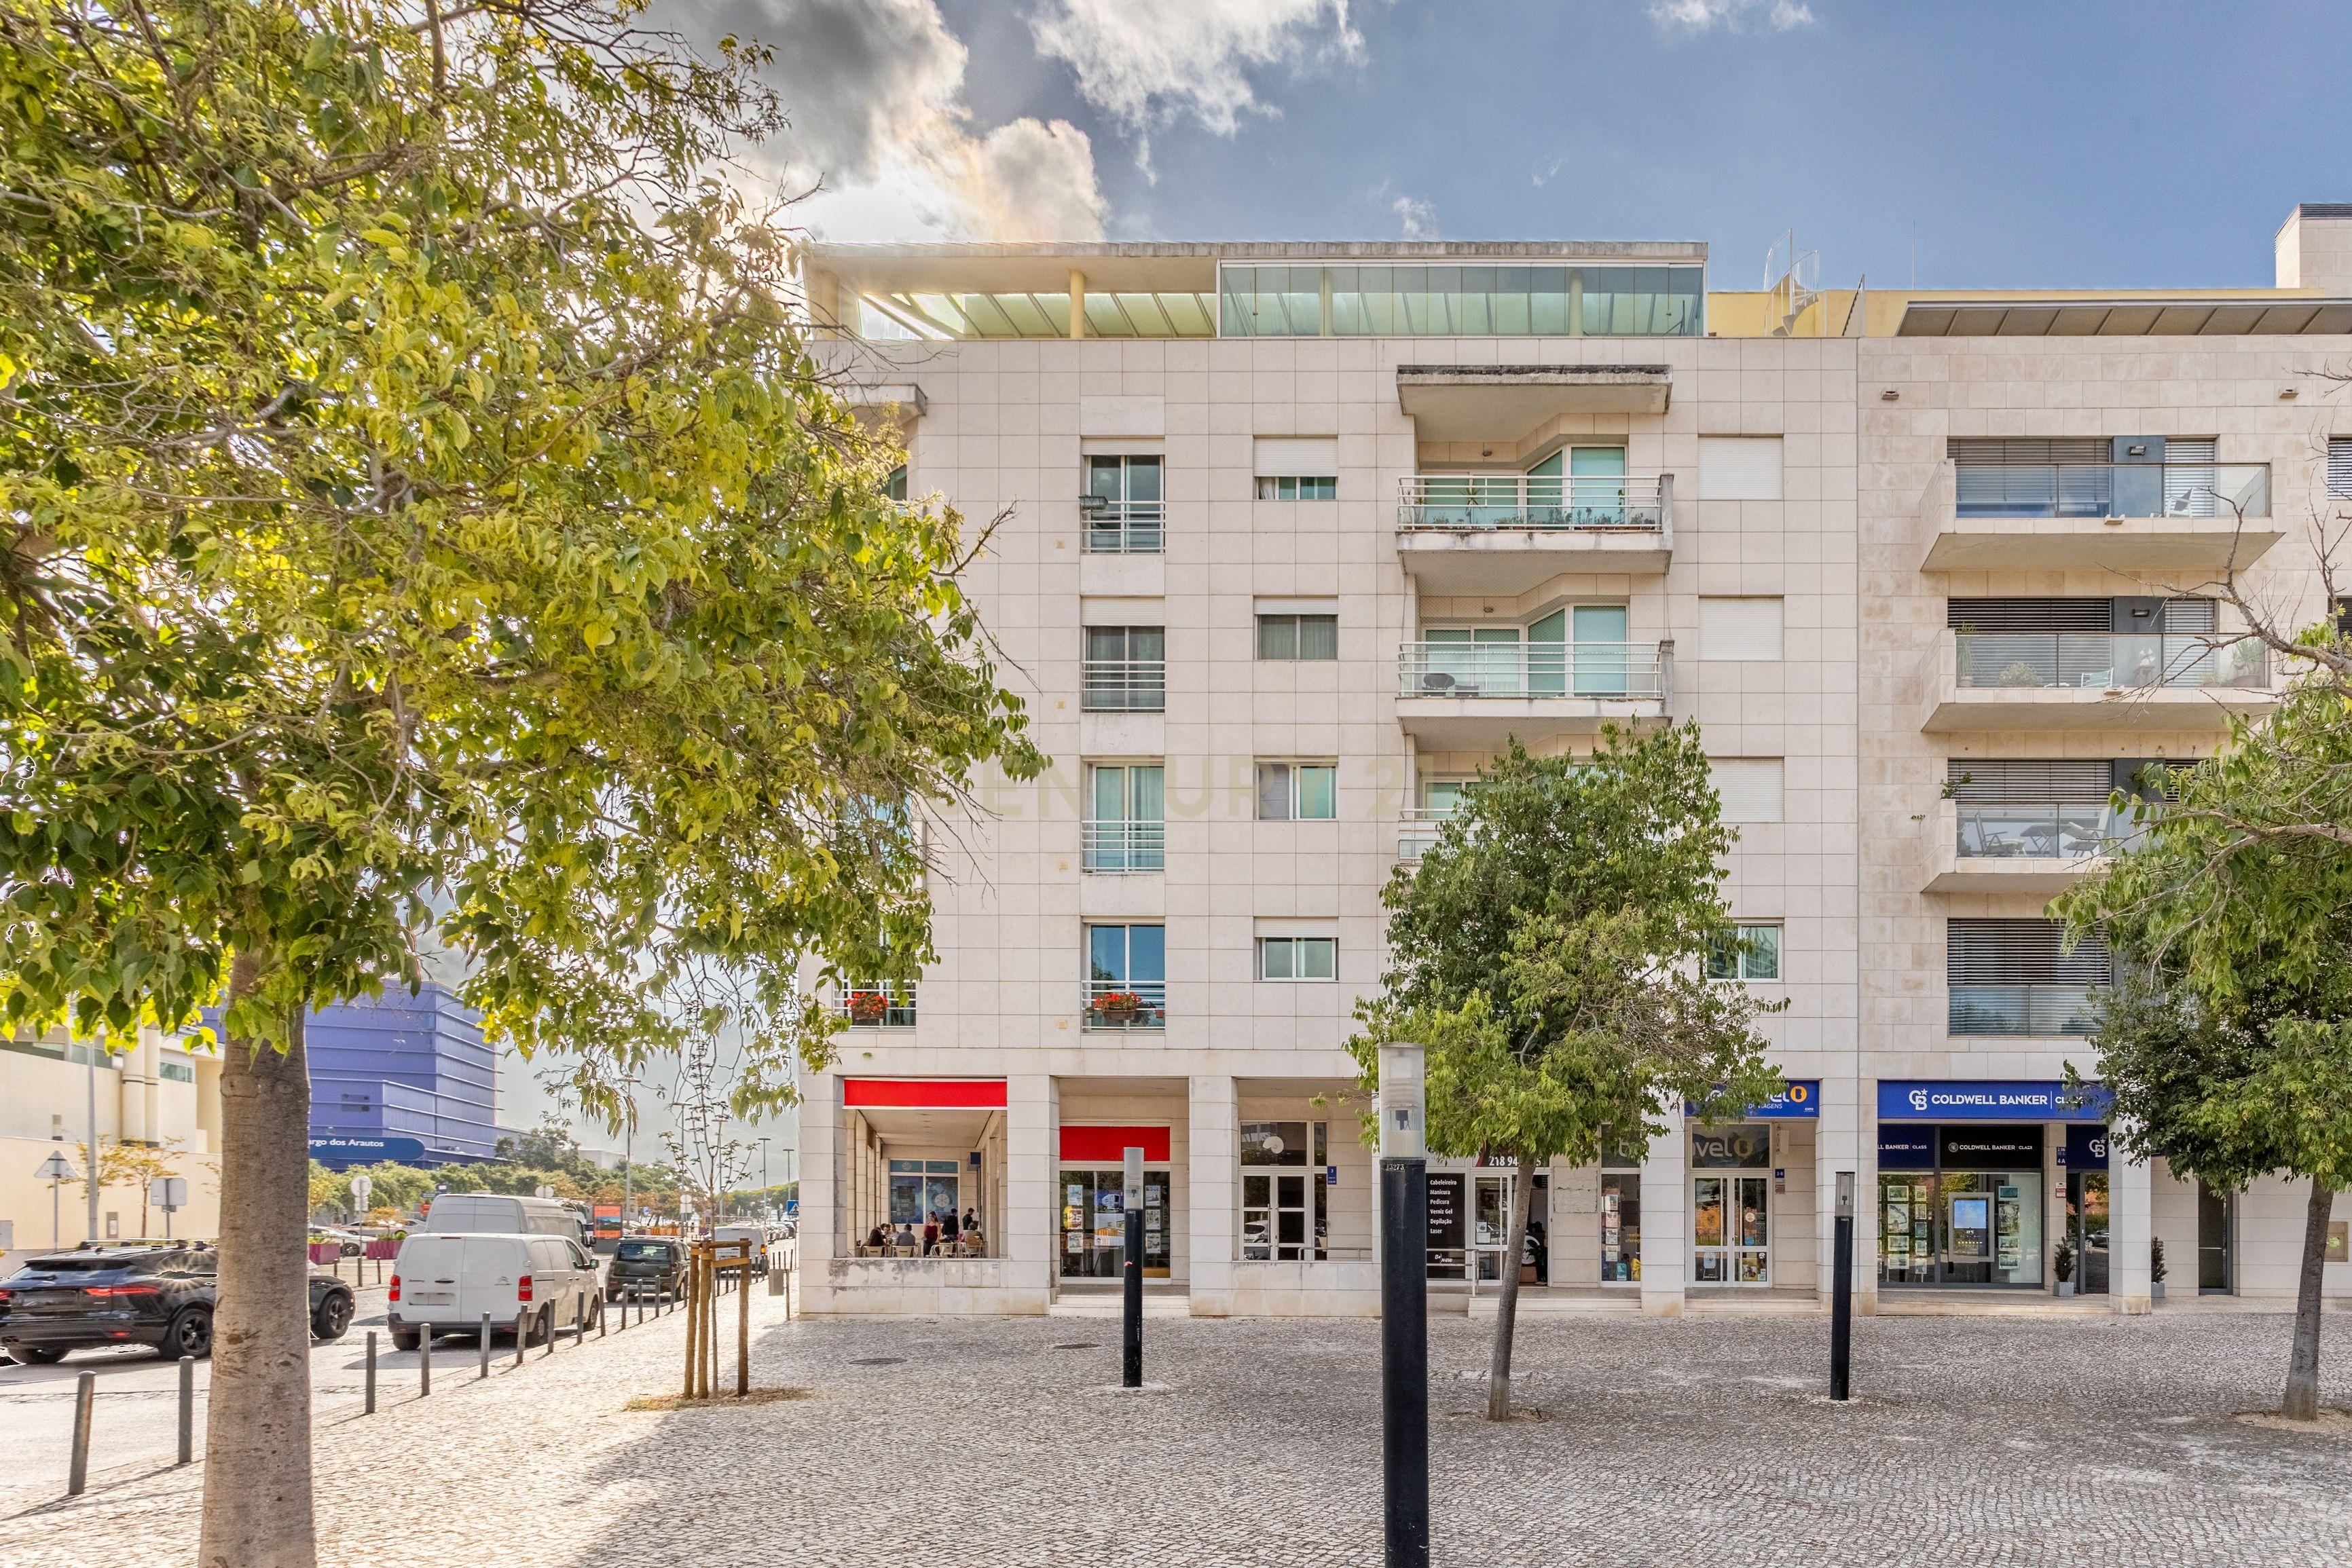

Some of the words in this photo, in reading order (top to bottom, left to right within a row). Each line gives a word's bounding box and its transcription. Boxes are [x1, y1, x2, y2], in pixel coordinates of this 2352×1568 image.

[1931, 1094, 1997, 1105] COLDWELL
[1999, 1095, 2048, 1105] BANKER
[329, 1138, 346, 1146] dos
[348, 1138, 384, 1147] Arautos
[1489, 1155, 1505, 1166] 218
[1507, 1155, 1520, 1166] 94
